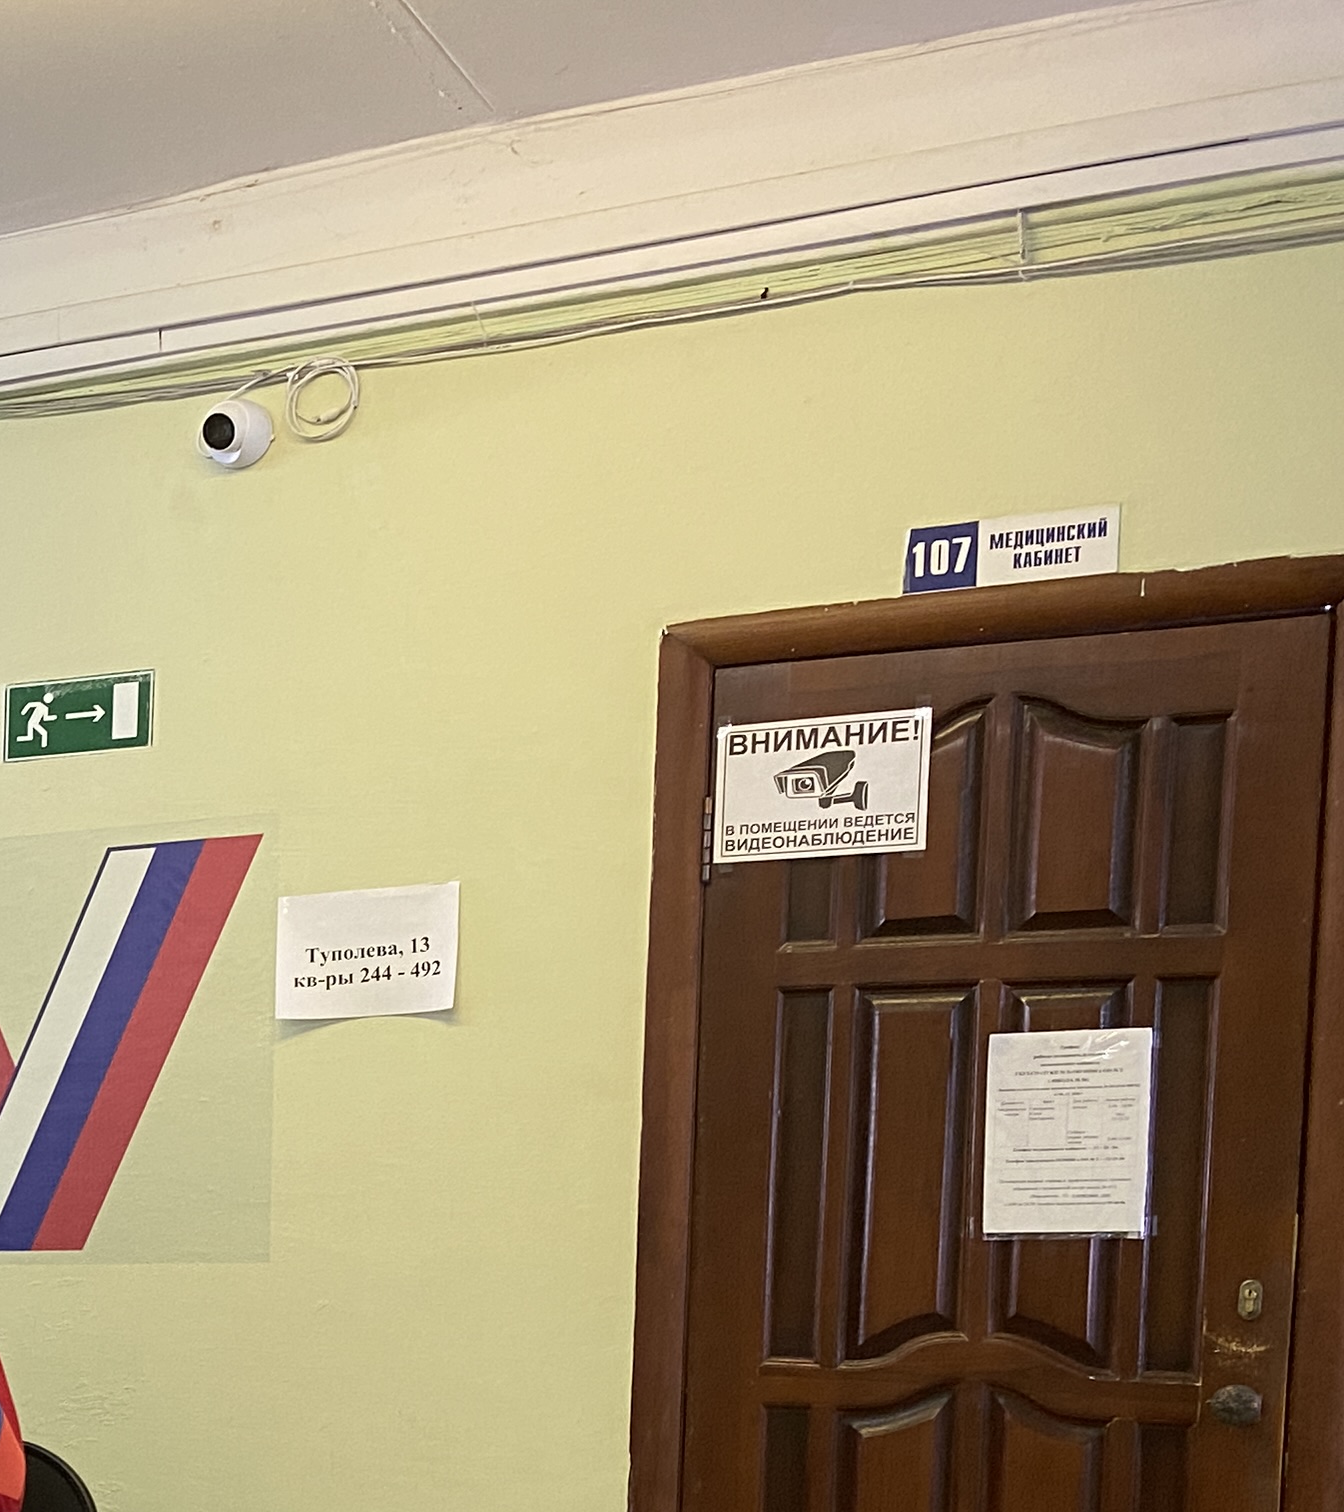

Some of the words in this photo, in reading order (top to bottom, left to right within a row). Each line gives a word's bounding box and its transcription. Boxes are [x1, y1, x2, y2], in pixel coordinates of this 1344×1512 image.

[989, 517, 1108, 551] МЕДИЦИНСКИЙ
[912, 536, 972, 578] 107
[1013, 546, 1082, 569] КАБИНЕТ
[729, 719, 920, 756] ВНИМАНИЕ!
[725, 825, 735, 836] В
[740, 818, 839, 835] ПОМЕЩЕНИИ
[843, 812, 916, 829] ВЕДЕТСЯ
[725, 827, 915, 853] ВИДЕОНАБЛЮДЕНИЕ
[305, 943, 404, 967] Туполева,
[411, 936, 430, 954] 13
[294, 972, 354, 990] кв-ры
[360, 965, 392, 984] 244
[410, 960, 441, 978] 492
